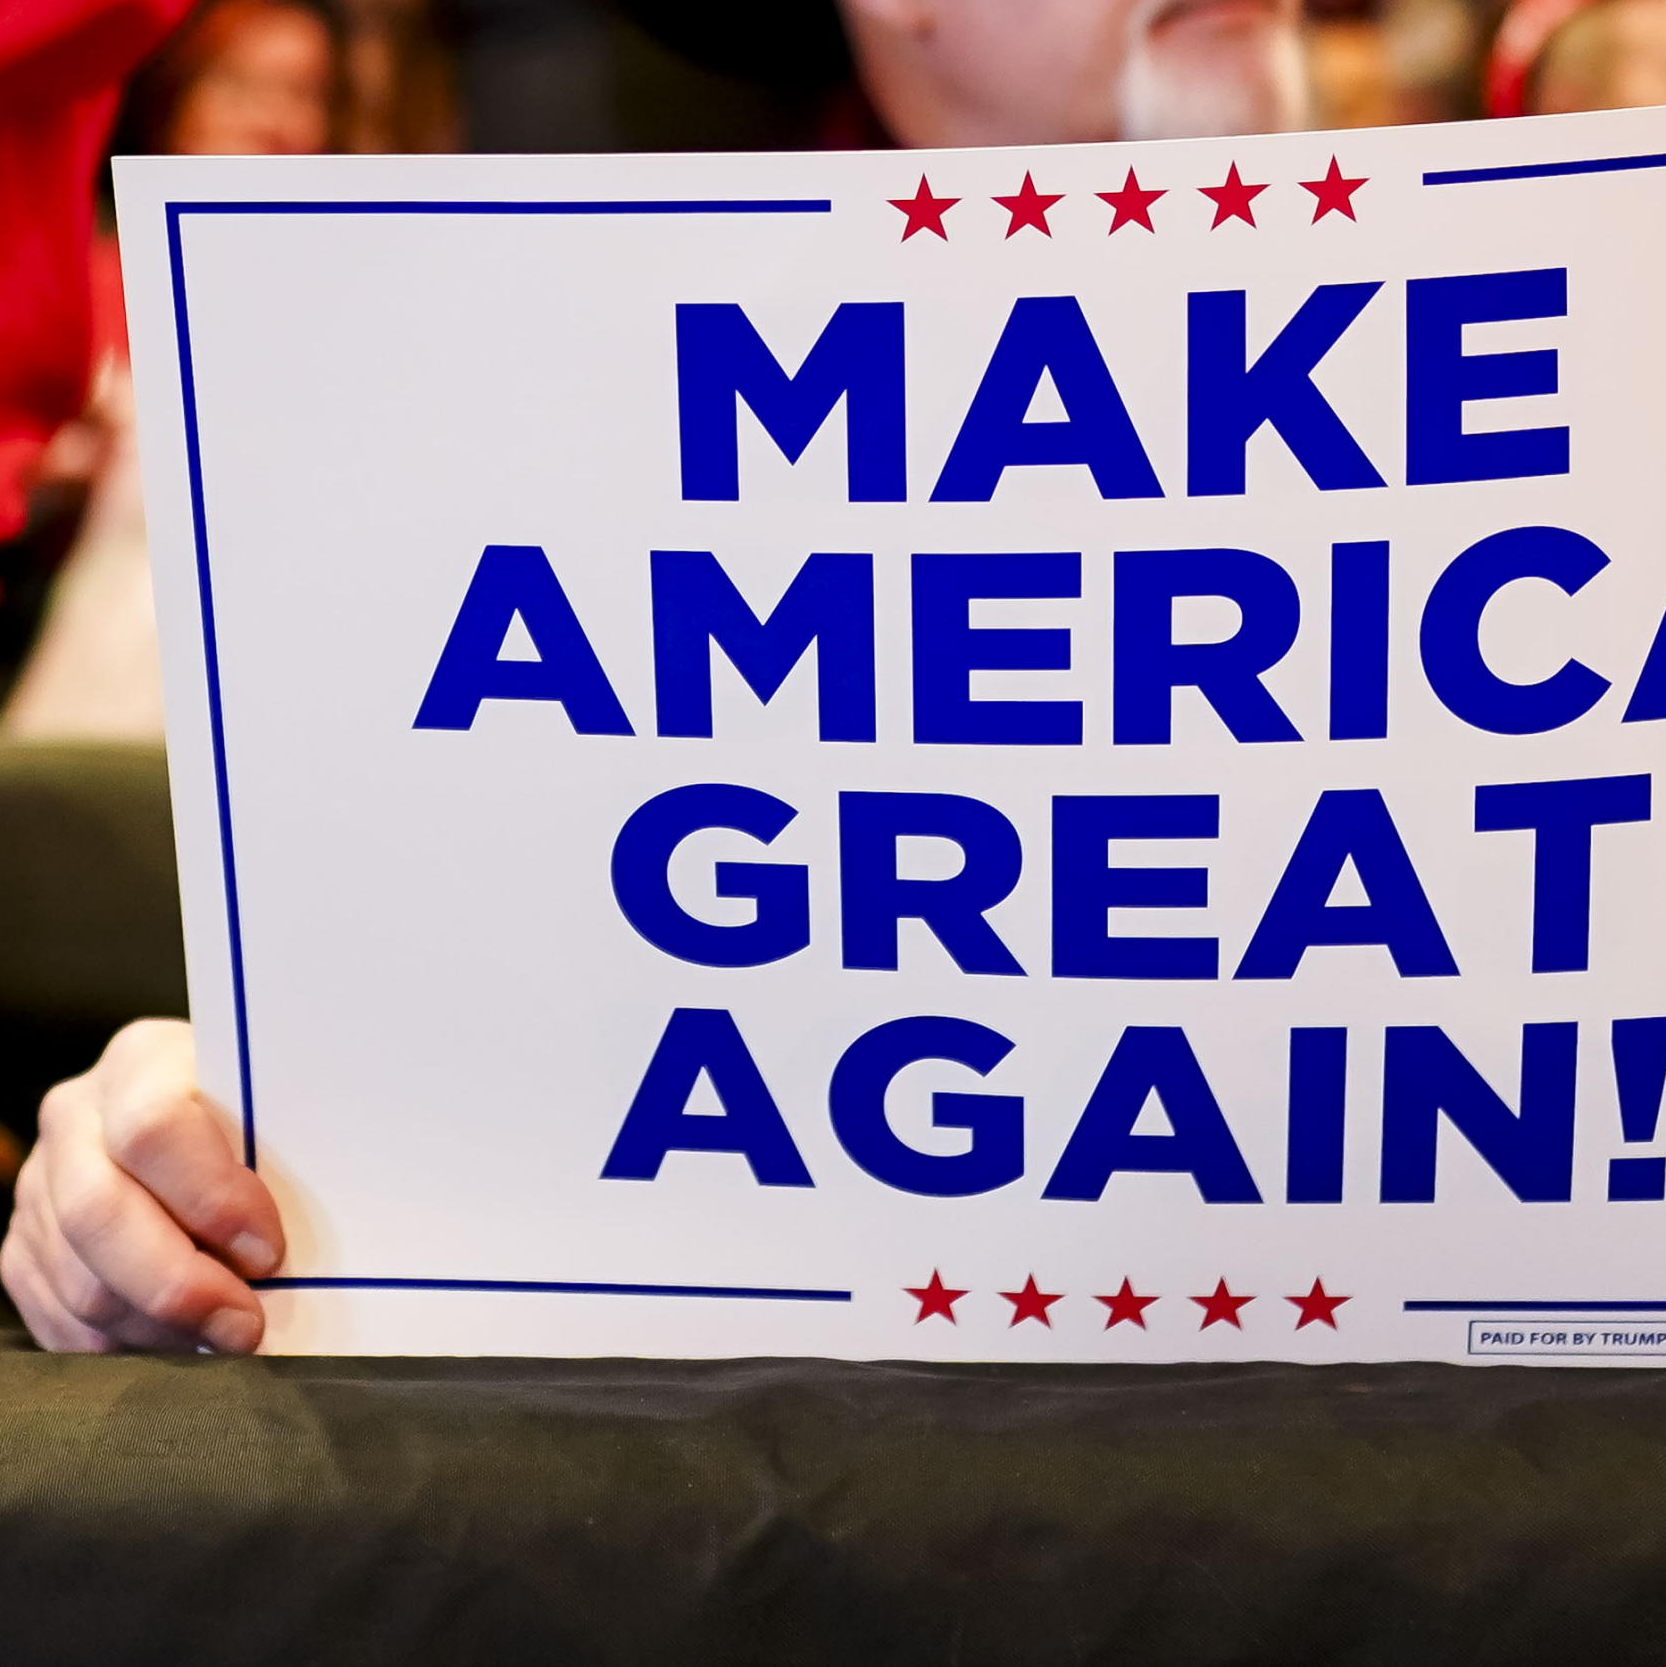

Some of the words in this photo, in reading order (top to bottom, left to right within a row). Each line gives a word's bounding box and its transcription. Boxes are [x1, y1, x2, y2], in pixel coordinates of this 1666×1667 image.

[676, 268, 1569, 502] MAKE
[611, 774, 1651, 979] GREAT
[1480, 1332, 1524, 1345] PAID
[1530, 1332, 1567, 1345] FOR
[1573, 1332, 1596, 1345] BY
